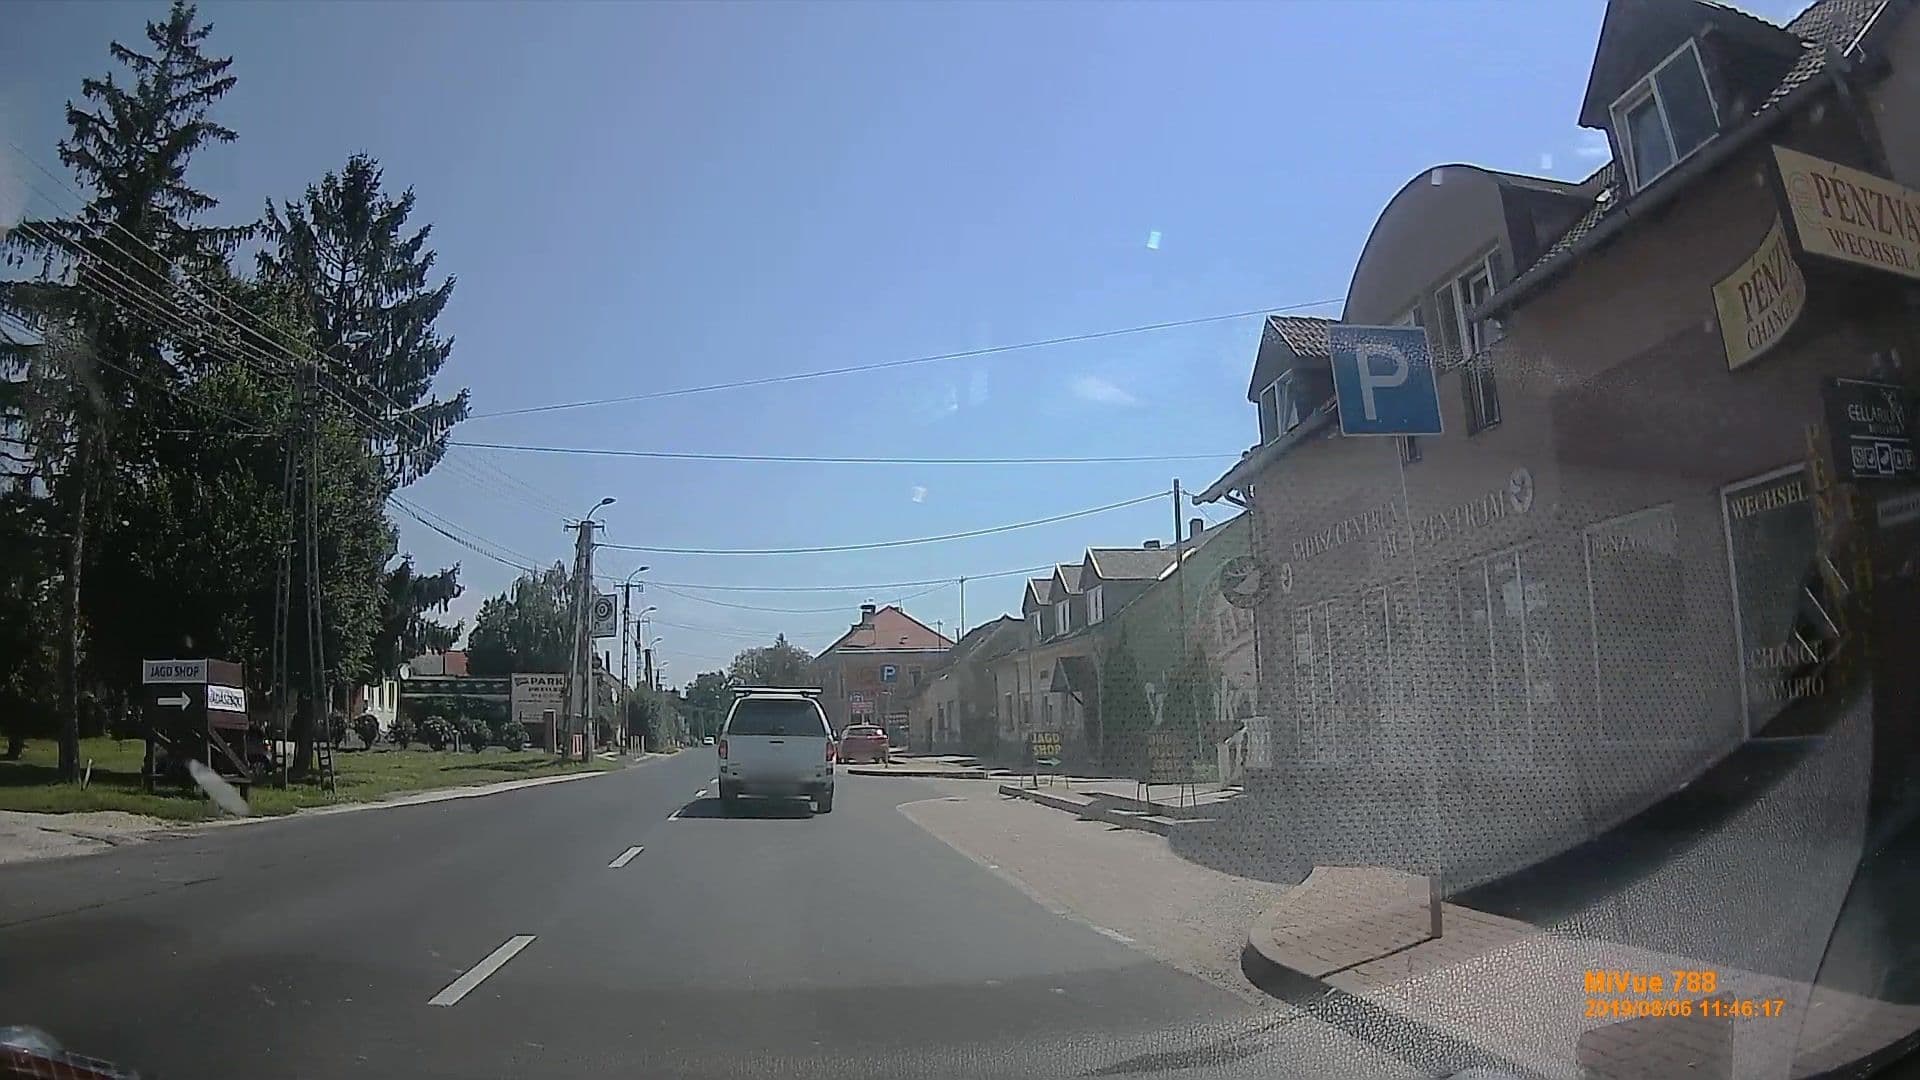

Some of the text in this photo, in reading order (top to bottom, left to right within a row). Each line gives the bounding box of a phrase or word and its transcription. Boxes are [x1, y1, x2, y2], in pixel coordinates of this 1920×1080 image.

[1811, 164, 1920, 248] PÉNZVÁ
[1356, 344, 1409, 420] P
[151, 666, 199, 677] JAGD SHOP
[884, 666, 896, 680] P
[530, 677, 563, 686] PARK
[1032, 733, 1060, 743] JAGD
[1033, 744, 1061, 755] SHOP
